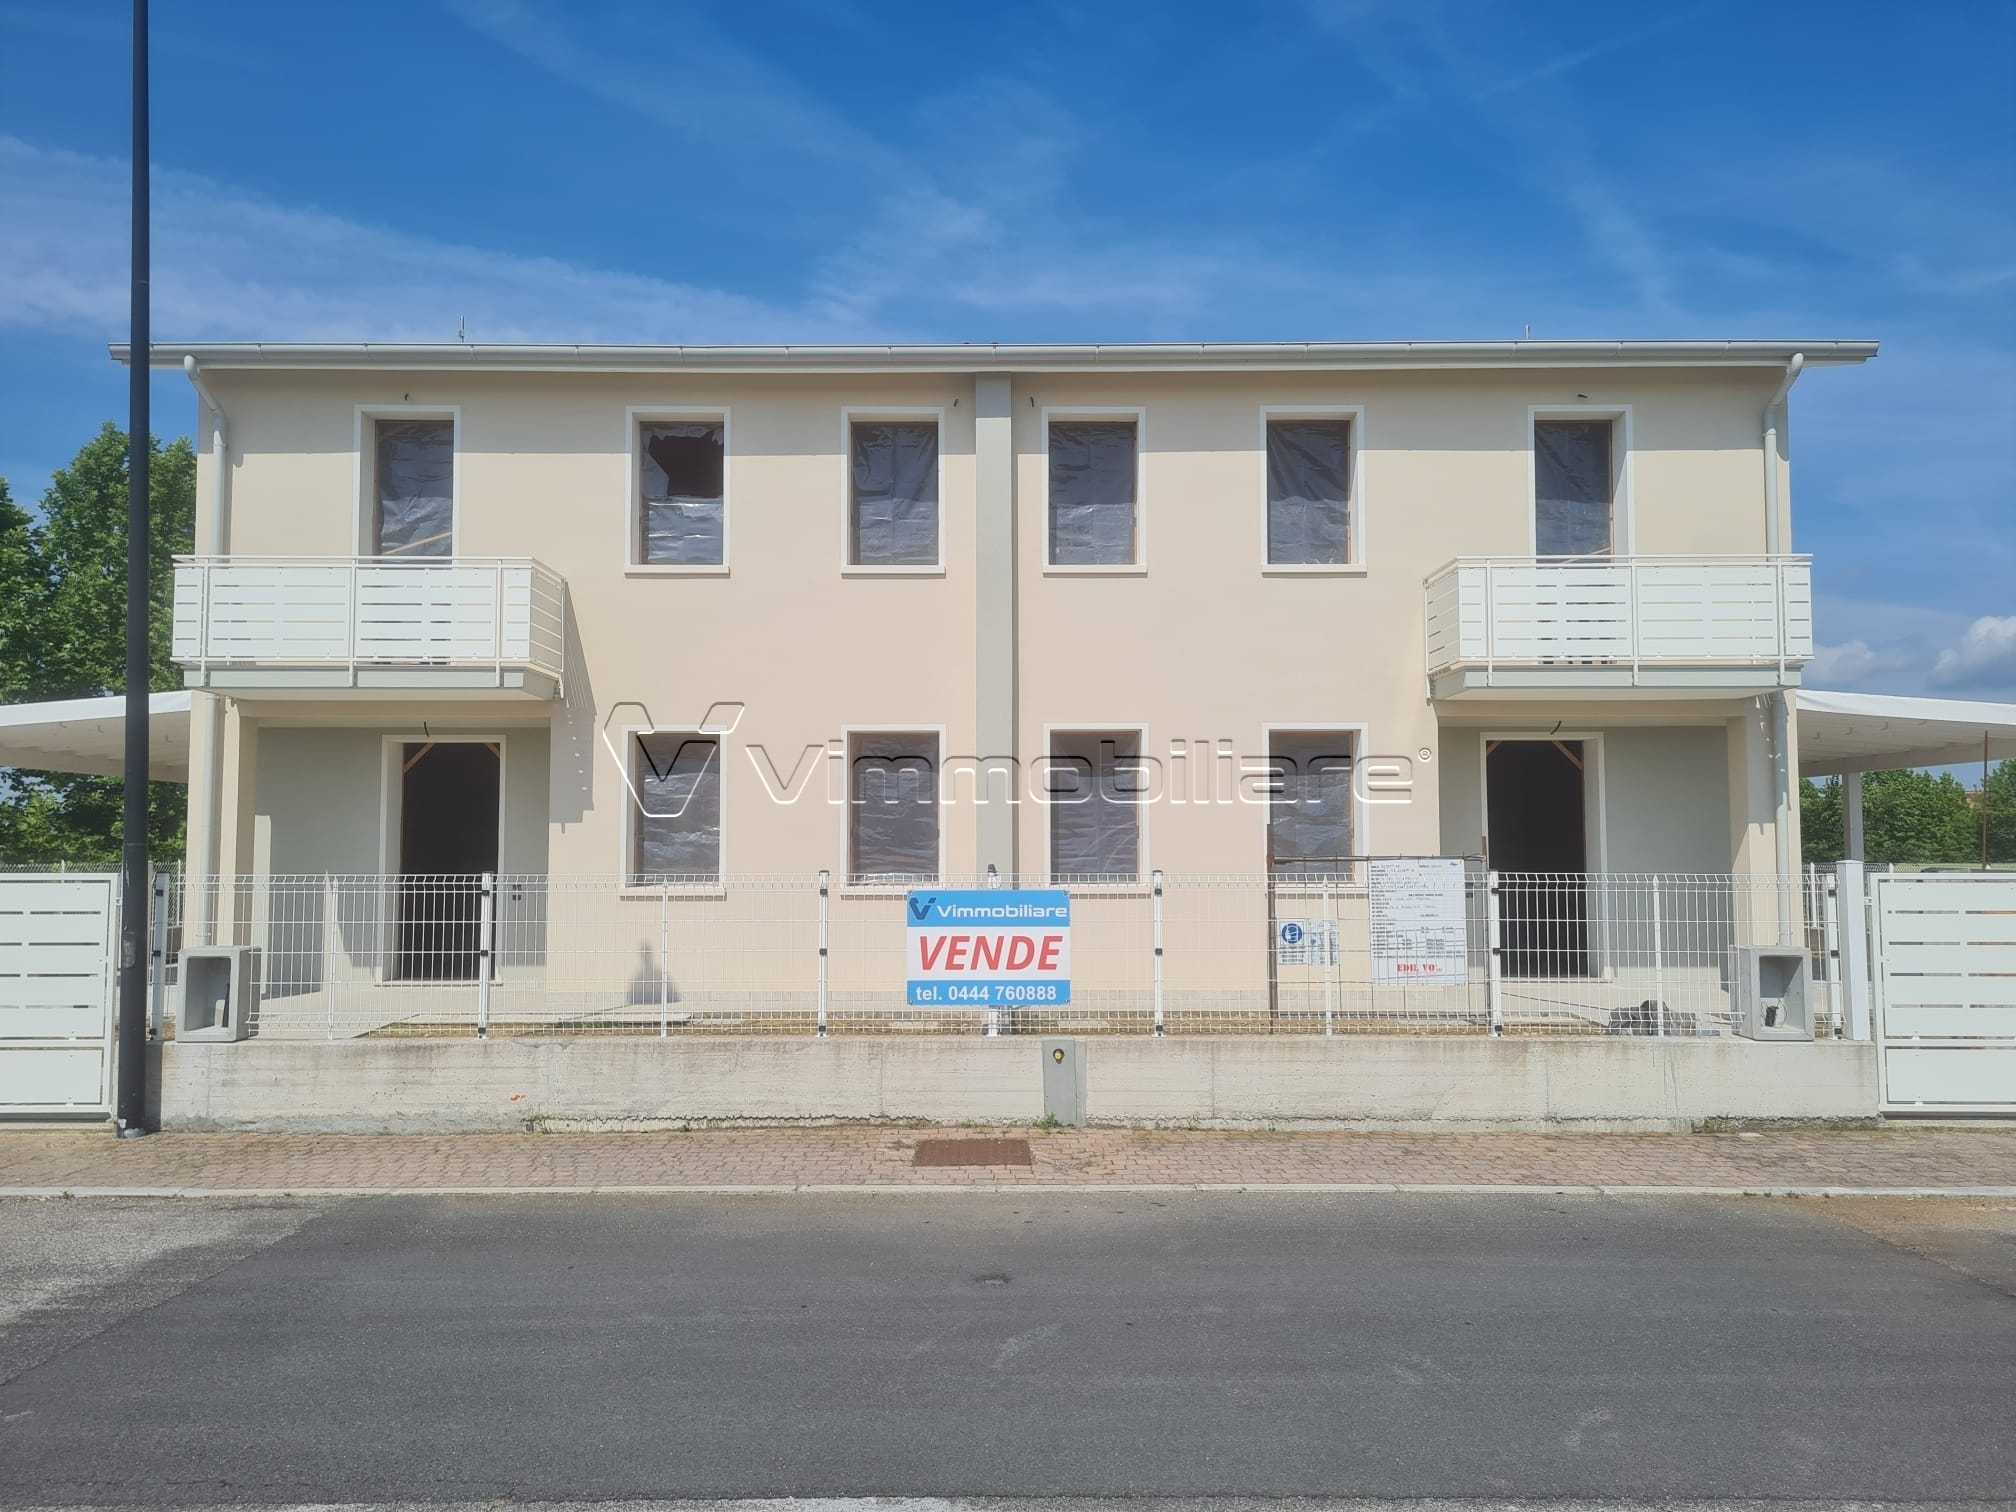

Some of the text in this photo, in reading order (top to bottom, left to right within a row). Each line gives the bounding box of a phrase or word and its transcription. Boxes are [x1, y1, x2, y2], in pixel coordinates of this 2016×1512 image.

[937, 904, 1068, 918] Vimmobiliare
[919, 935, 1064, 971] VENDE
[915, 985, 1057, 1001] tel. 0444 760888
